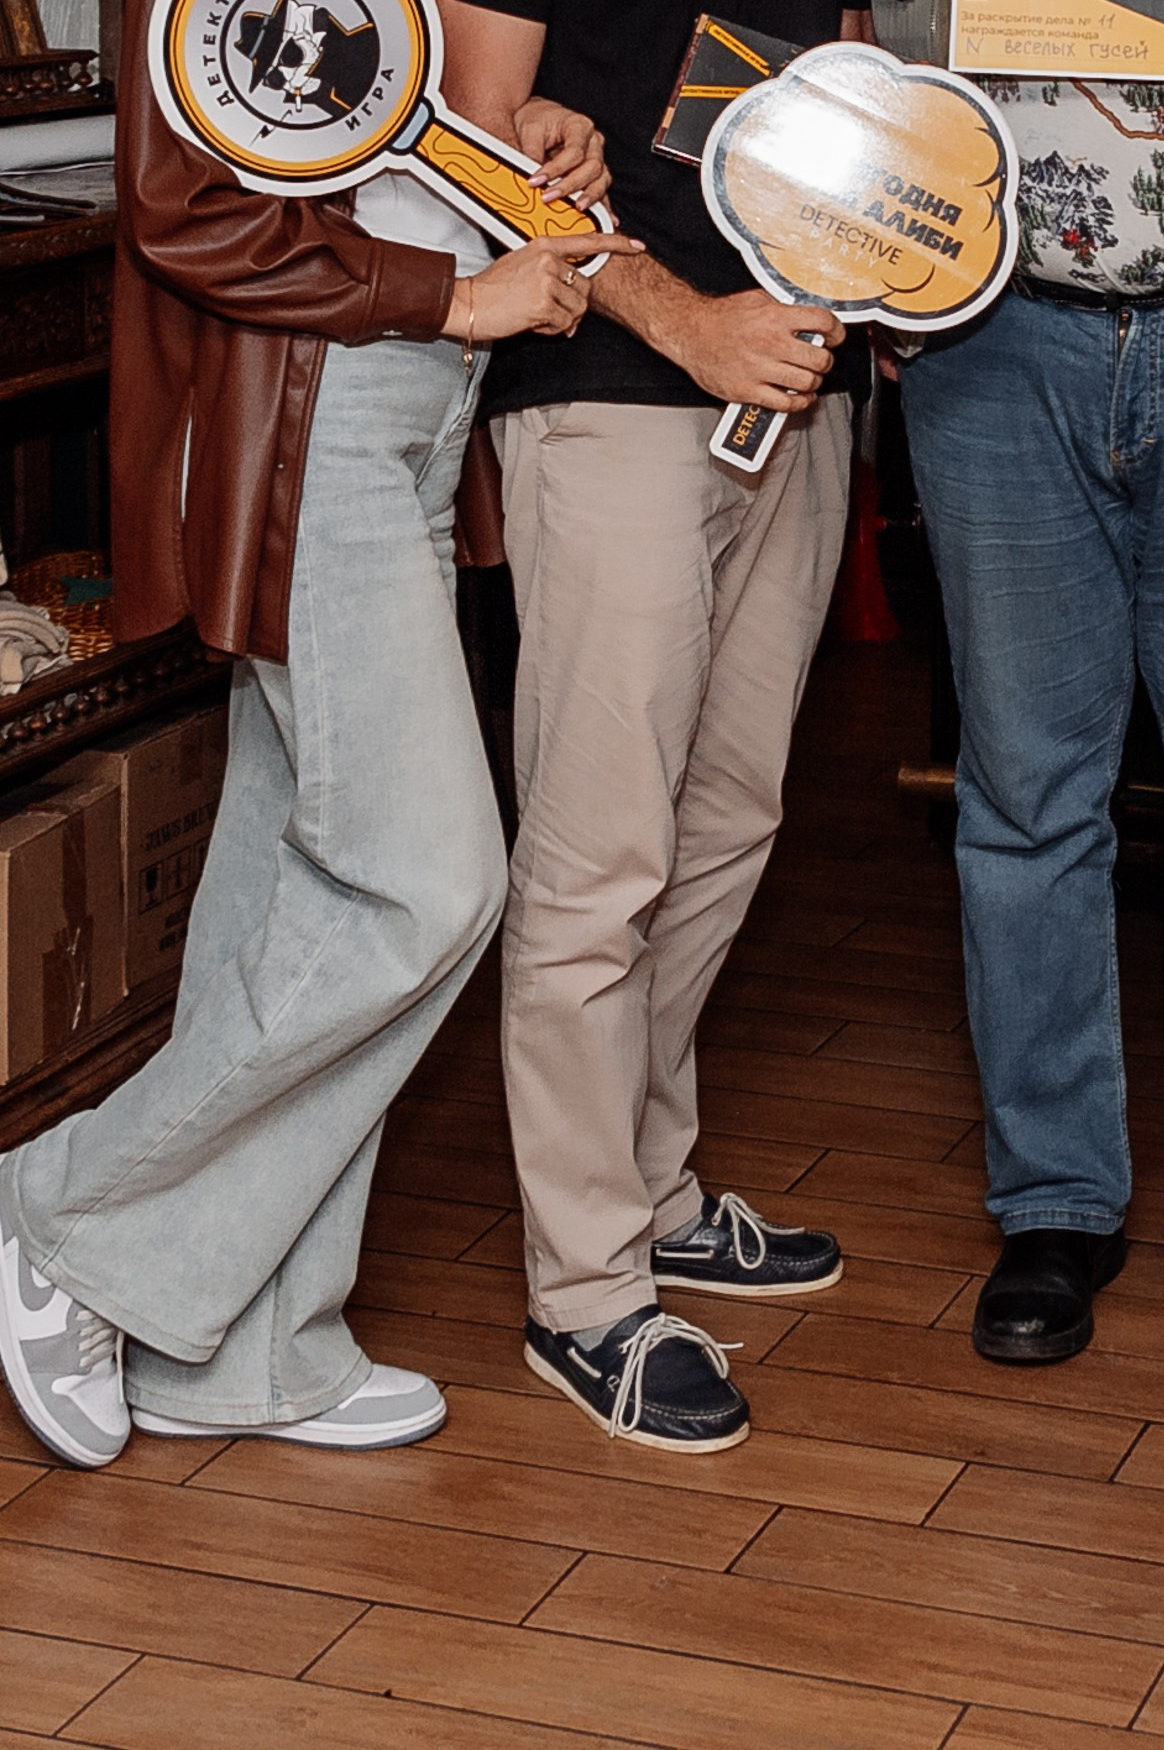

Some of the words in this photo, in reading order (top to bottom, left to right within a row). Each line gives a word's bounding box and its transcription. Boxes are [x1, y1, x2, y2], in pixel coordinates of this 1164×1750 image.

[961, 10, 974, 21] За
[978, 12, 1043, 26] раскрытие
[1045, 15, 1074, 26] дела
[961, 26, 1045, 38] награждается
[1048, 29, 1099, 40] команда
[1004, 39, 1076, 58] веселых
[1089, 40, 1149, 60] гусей
[345, 66, 396, 132] ИГРА
[800, 203, 904, 266] DETECTIVE
[808, 228, 879, 268] PARTY
[862, 200, 964, 261] АЛИБИ
